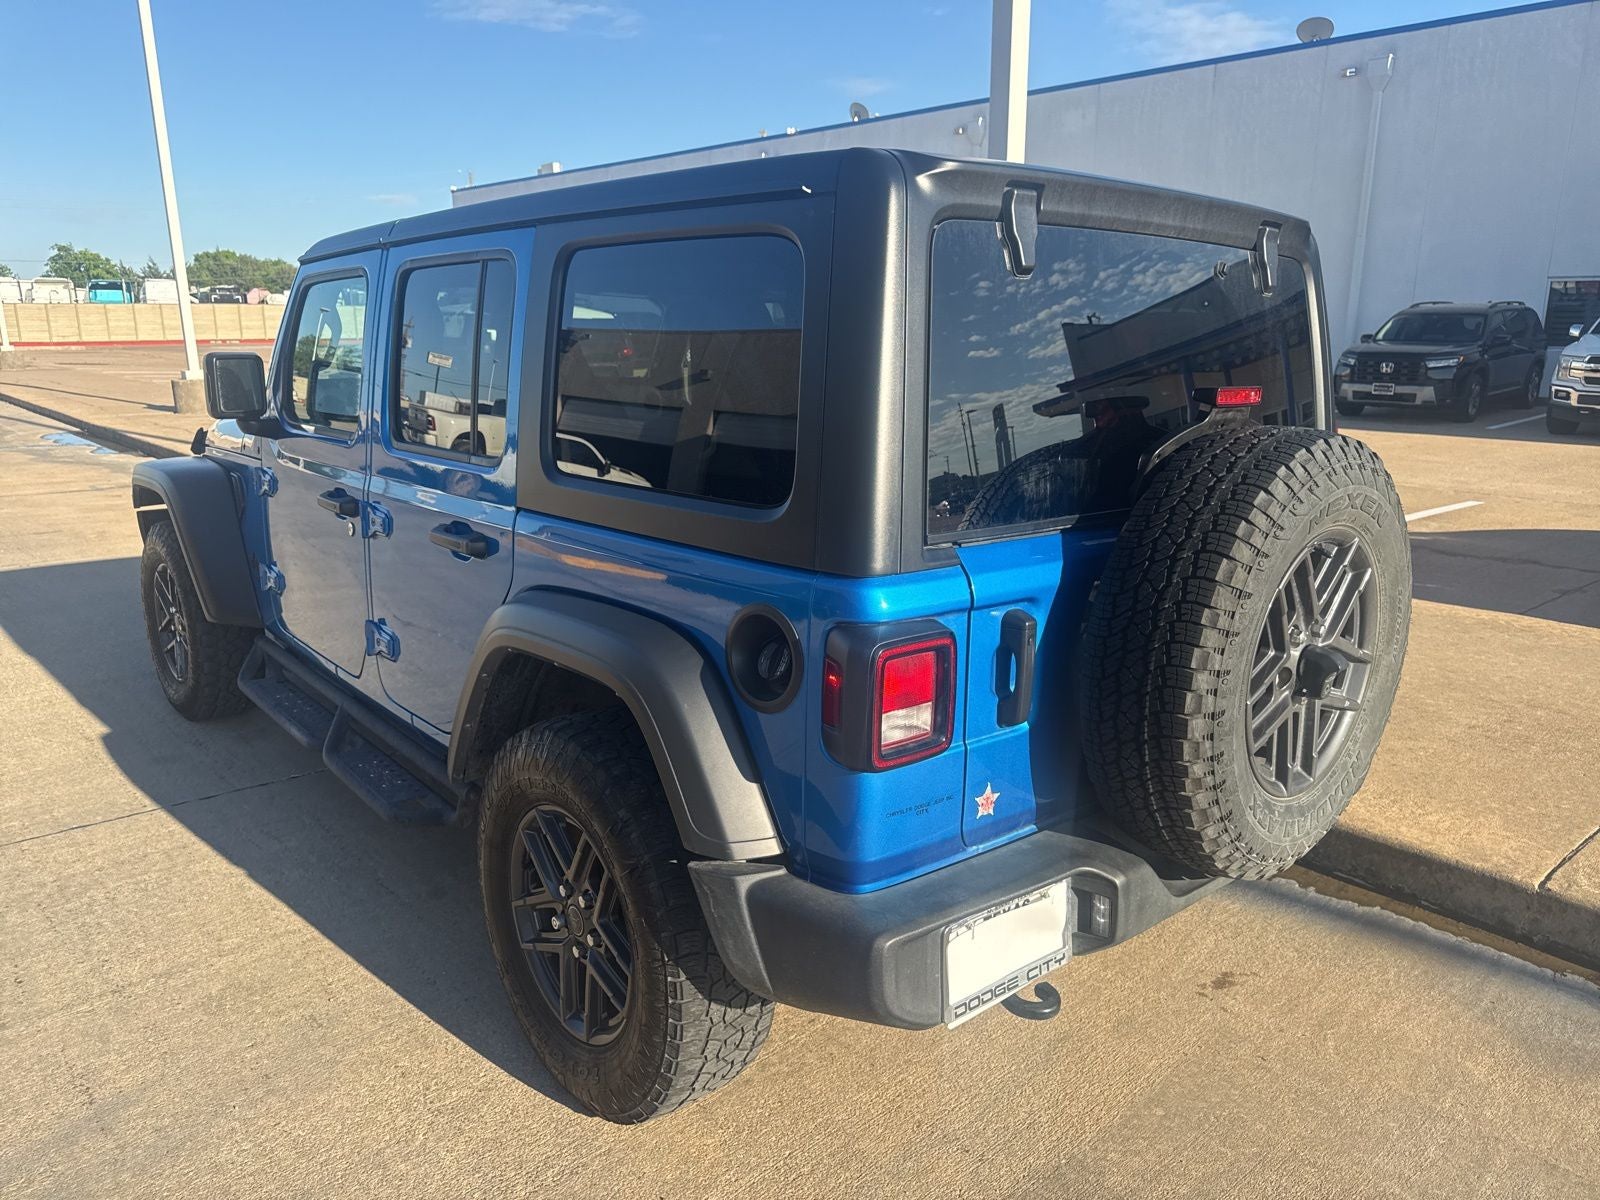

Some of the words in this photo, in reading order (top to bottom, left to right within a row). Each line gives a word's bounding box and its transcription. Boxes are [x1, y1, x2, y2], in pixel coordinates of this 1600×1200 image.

[1307, 491, 1389, 535] NEXEN
[1281, 749, 1370, 839] ROADIAN
[954, 975, 1020, 1019] DODGE
[1027, 952, 1066, 981] CITY
